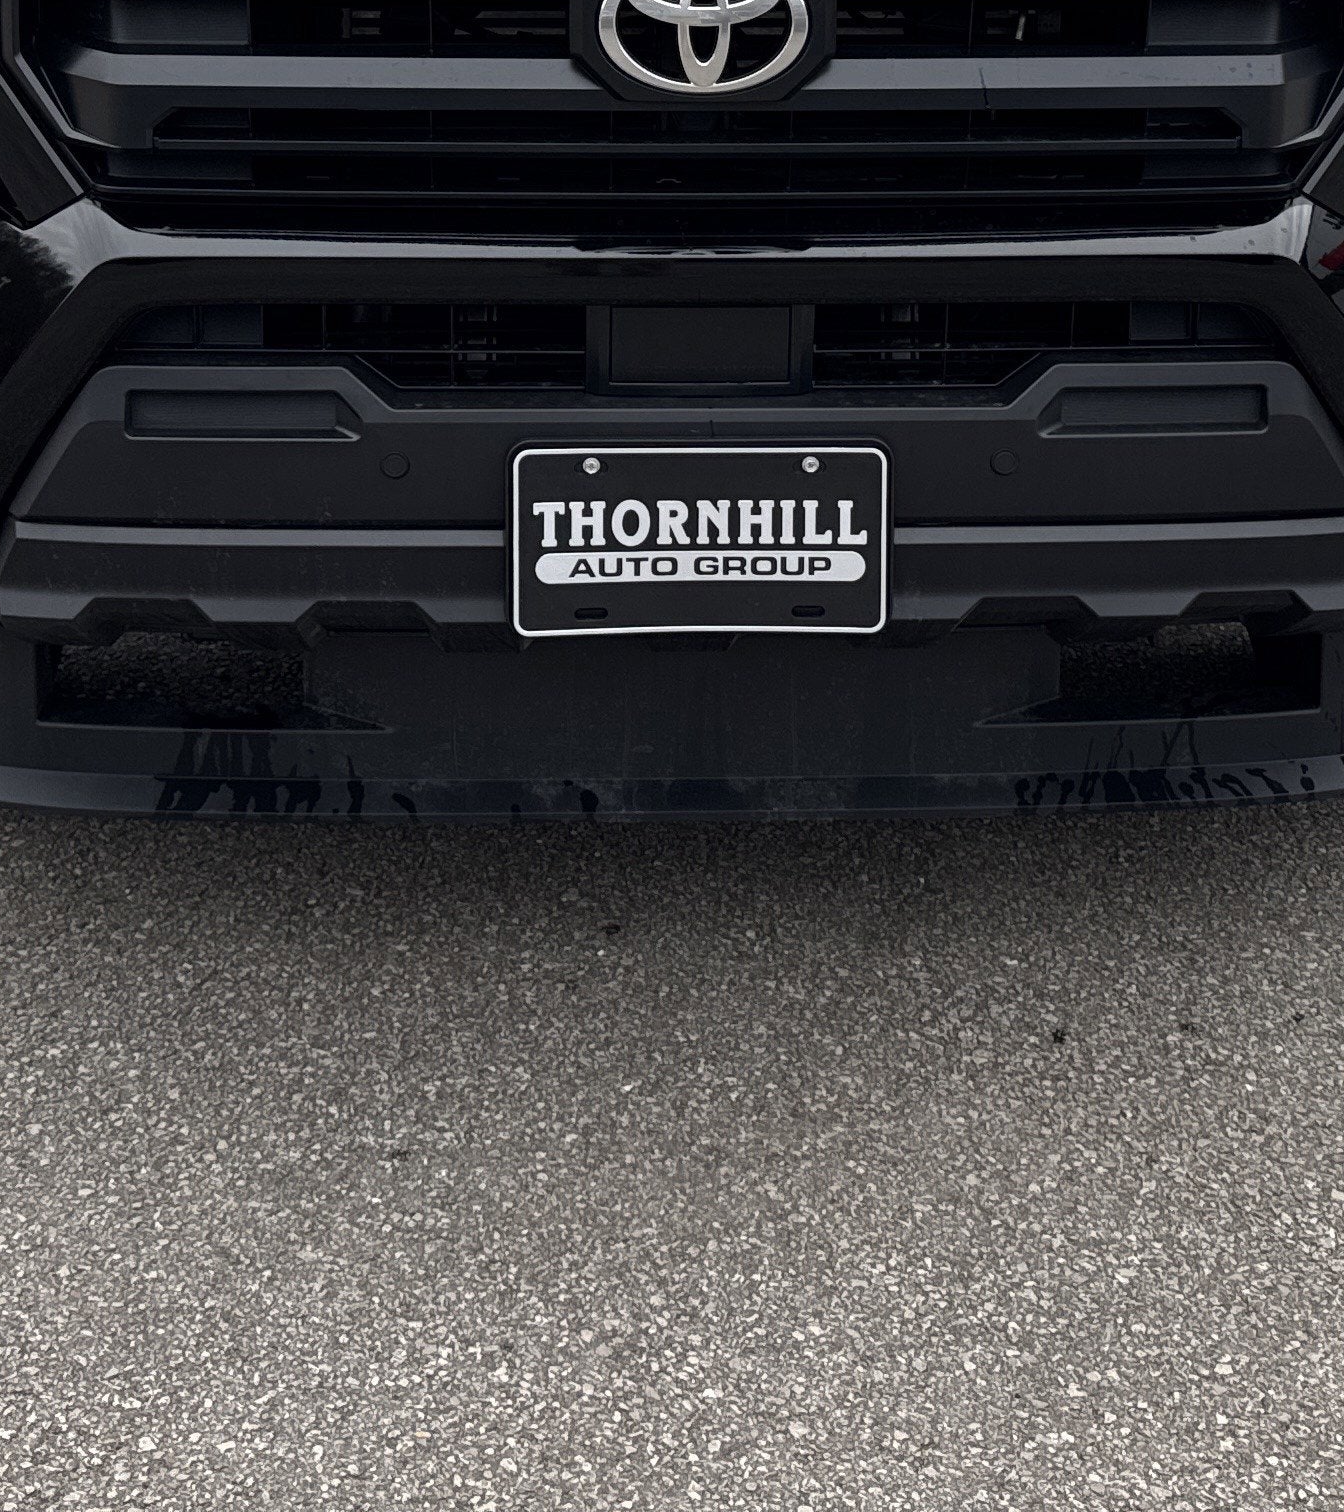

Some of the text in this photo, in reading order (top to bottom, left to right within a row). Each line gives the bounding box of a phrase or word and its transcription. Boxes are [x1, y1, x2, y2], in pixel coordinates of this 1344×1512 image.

[532, 499, 868, 547] THORNHILL
[568, 556, 832, 578] AUTO GROUP
